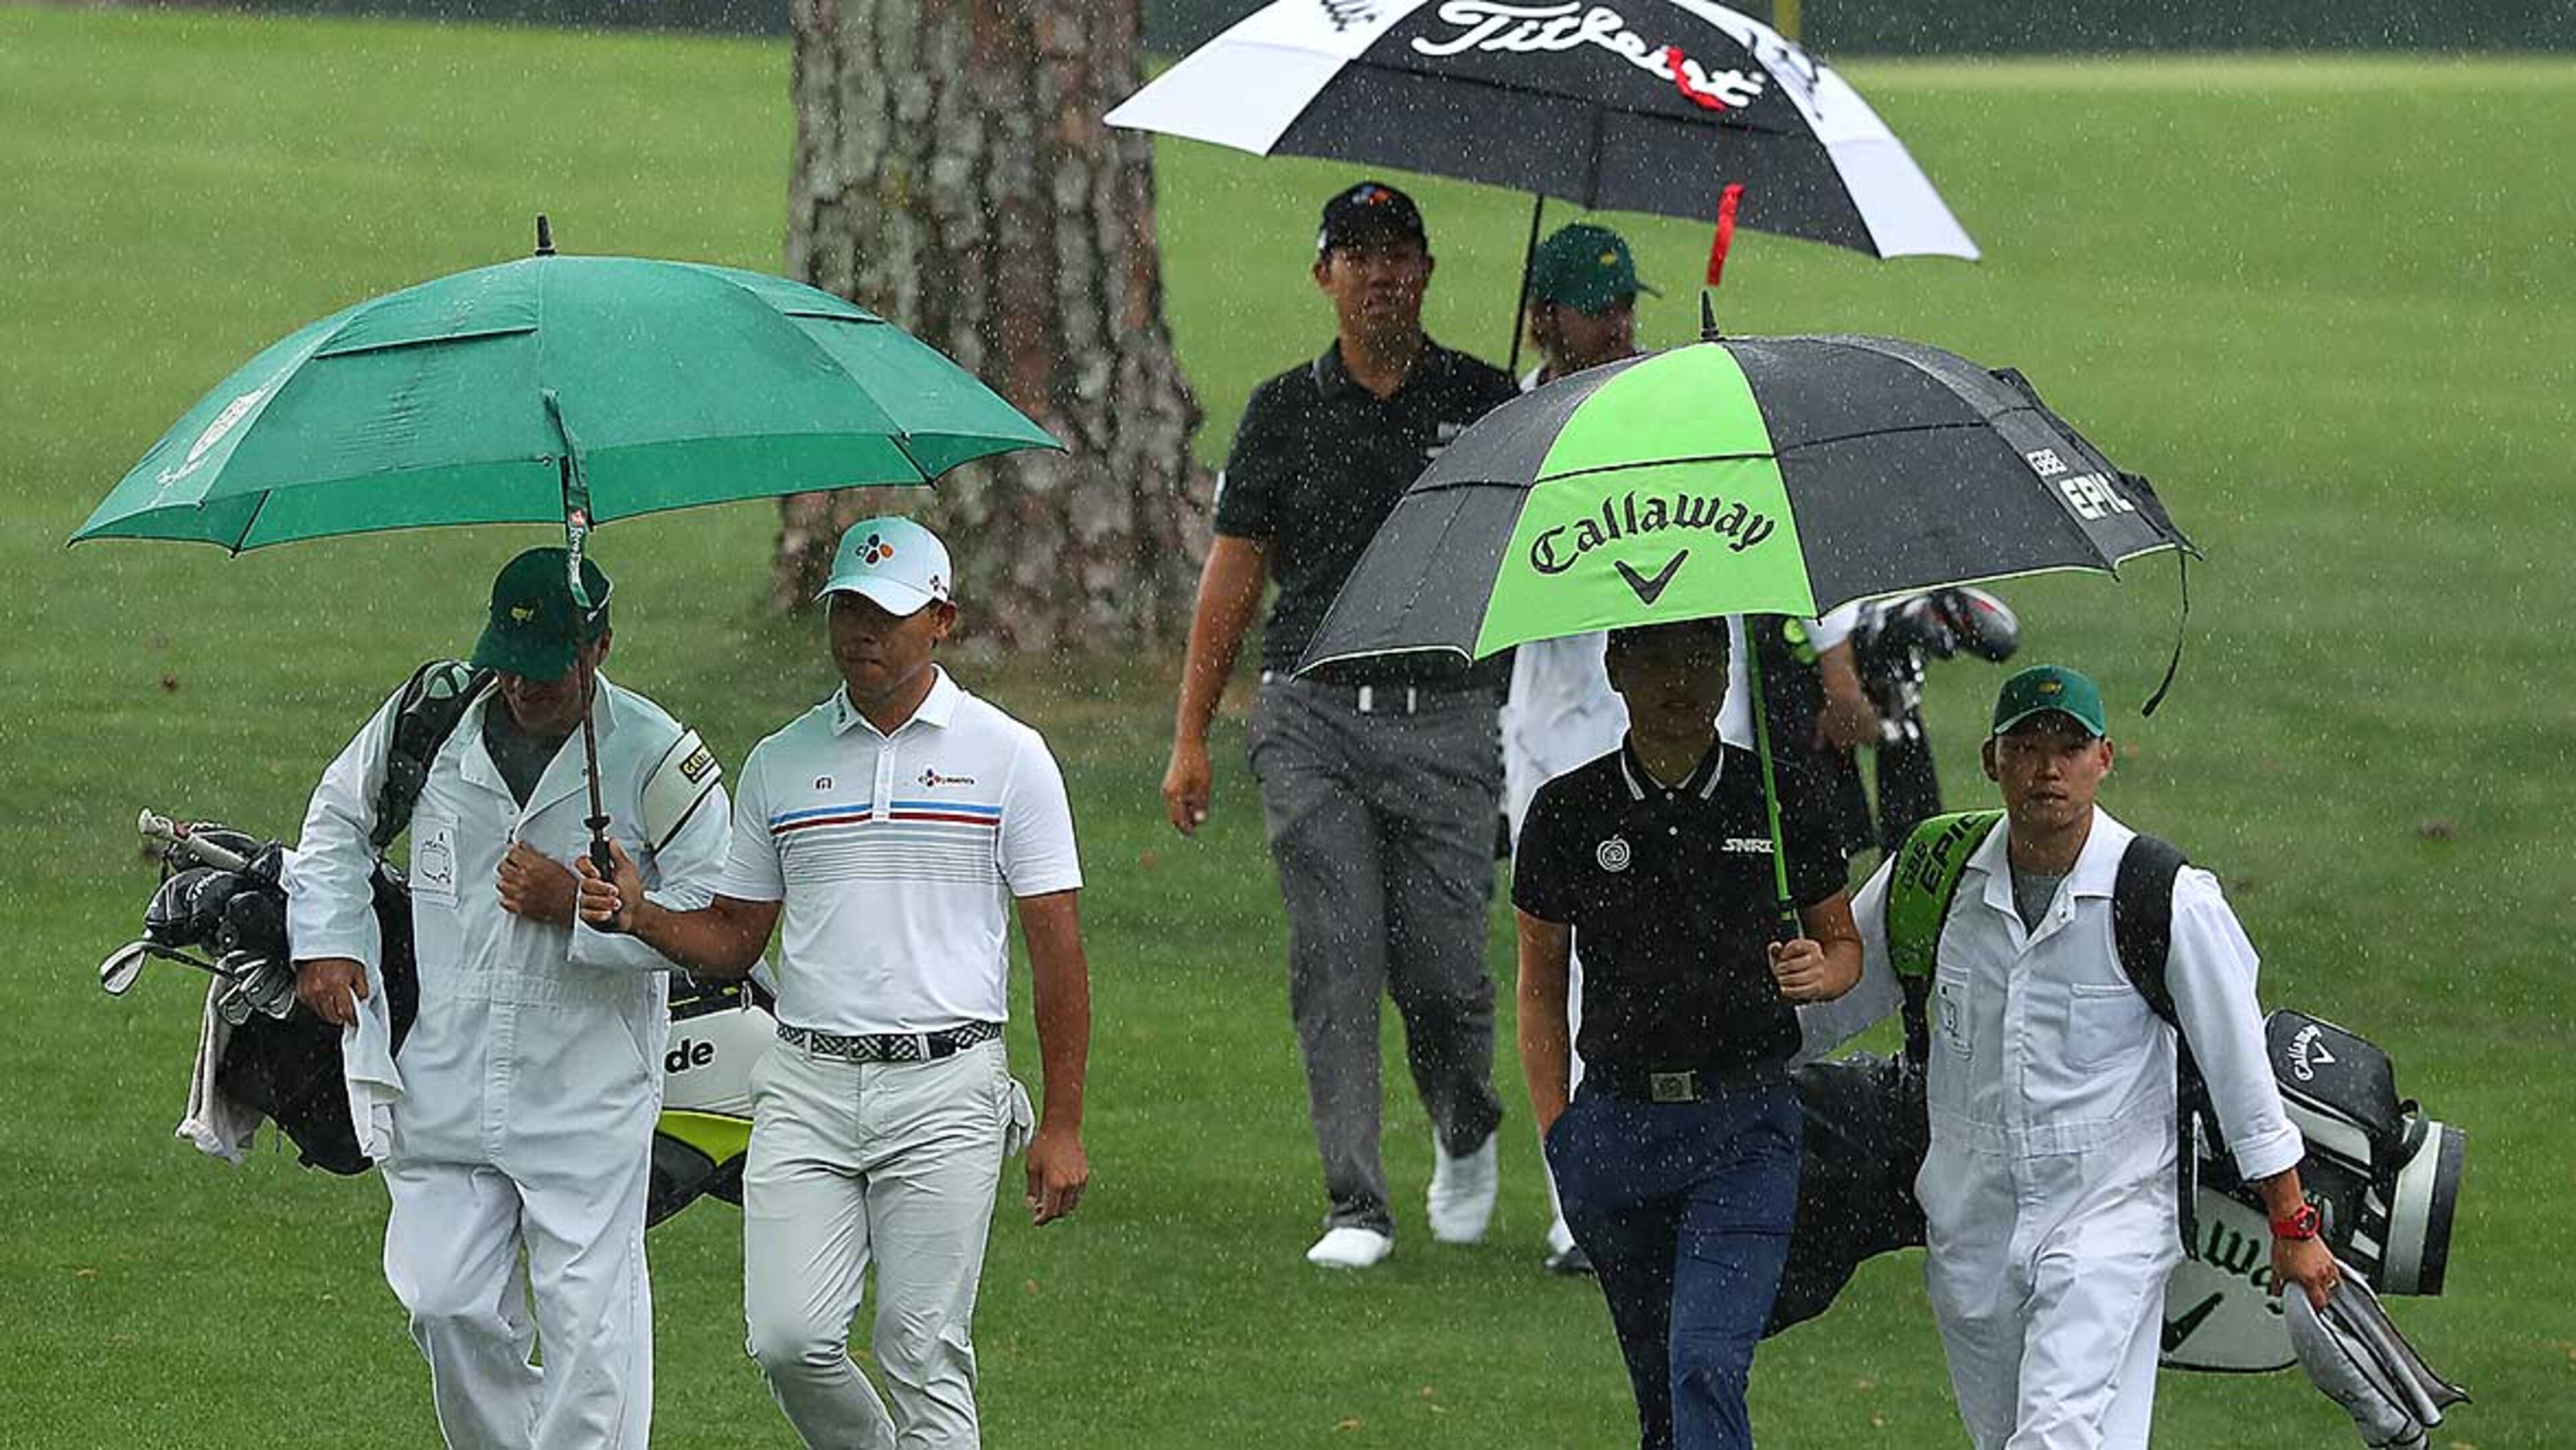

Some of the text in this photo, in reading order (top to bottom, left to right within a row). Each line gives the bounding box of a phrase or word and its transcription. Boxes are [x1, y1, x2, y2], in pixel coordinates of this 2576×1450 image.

[1530, 490, 1775, 574] Callaway
[2059, 471, 2135, 520] EPIC
[1920, 814, 1987, 895] EPIC
